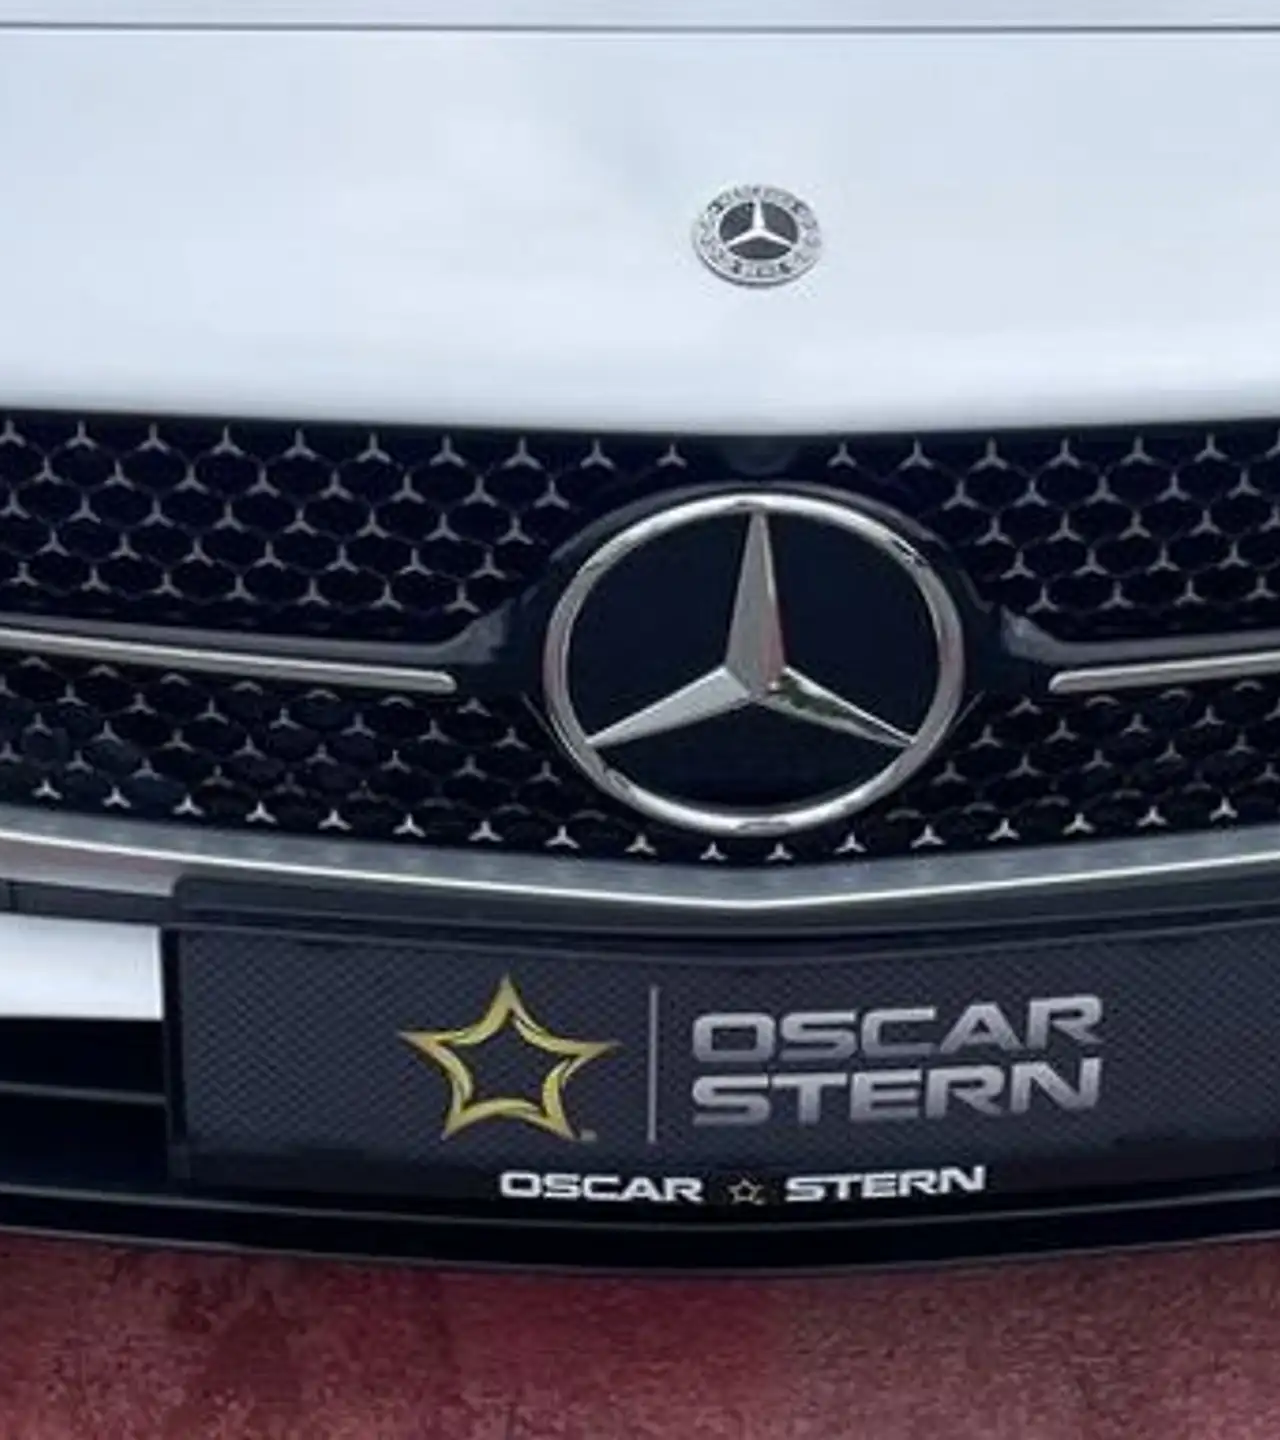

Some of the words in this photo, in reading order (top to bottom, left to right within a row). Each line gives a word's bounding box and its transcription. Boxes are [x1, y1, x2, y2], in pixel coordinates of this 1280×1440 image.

[691, 994, 1105, 1062] OSCAR
[691, 1057, 1102, 1127] STERN
[499, 1170, 704, 1204] OSCAR
[785, 1164, 986, 1202] STERN
